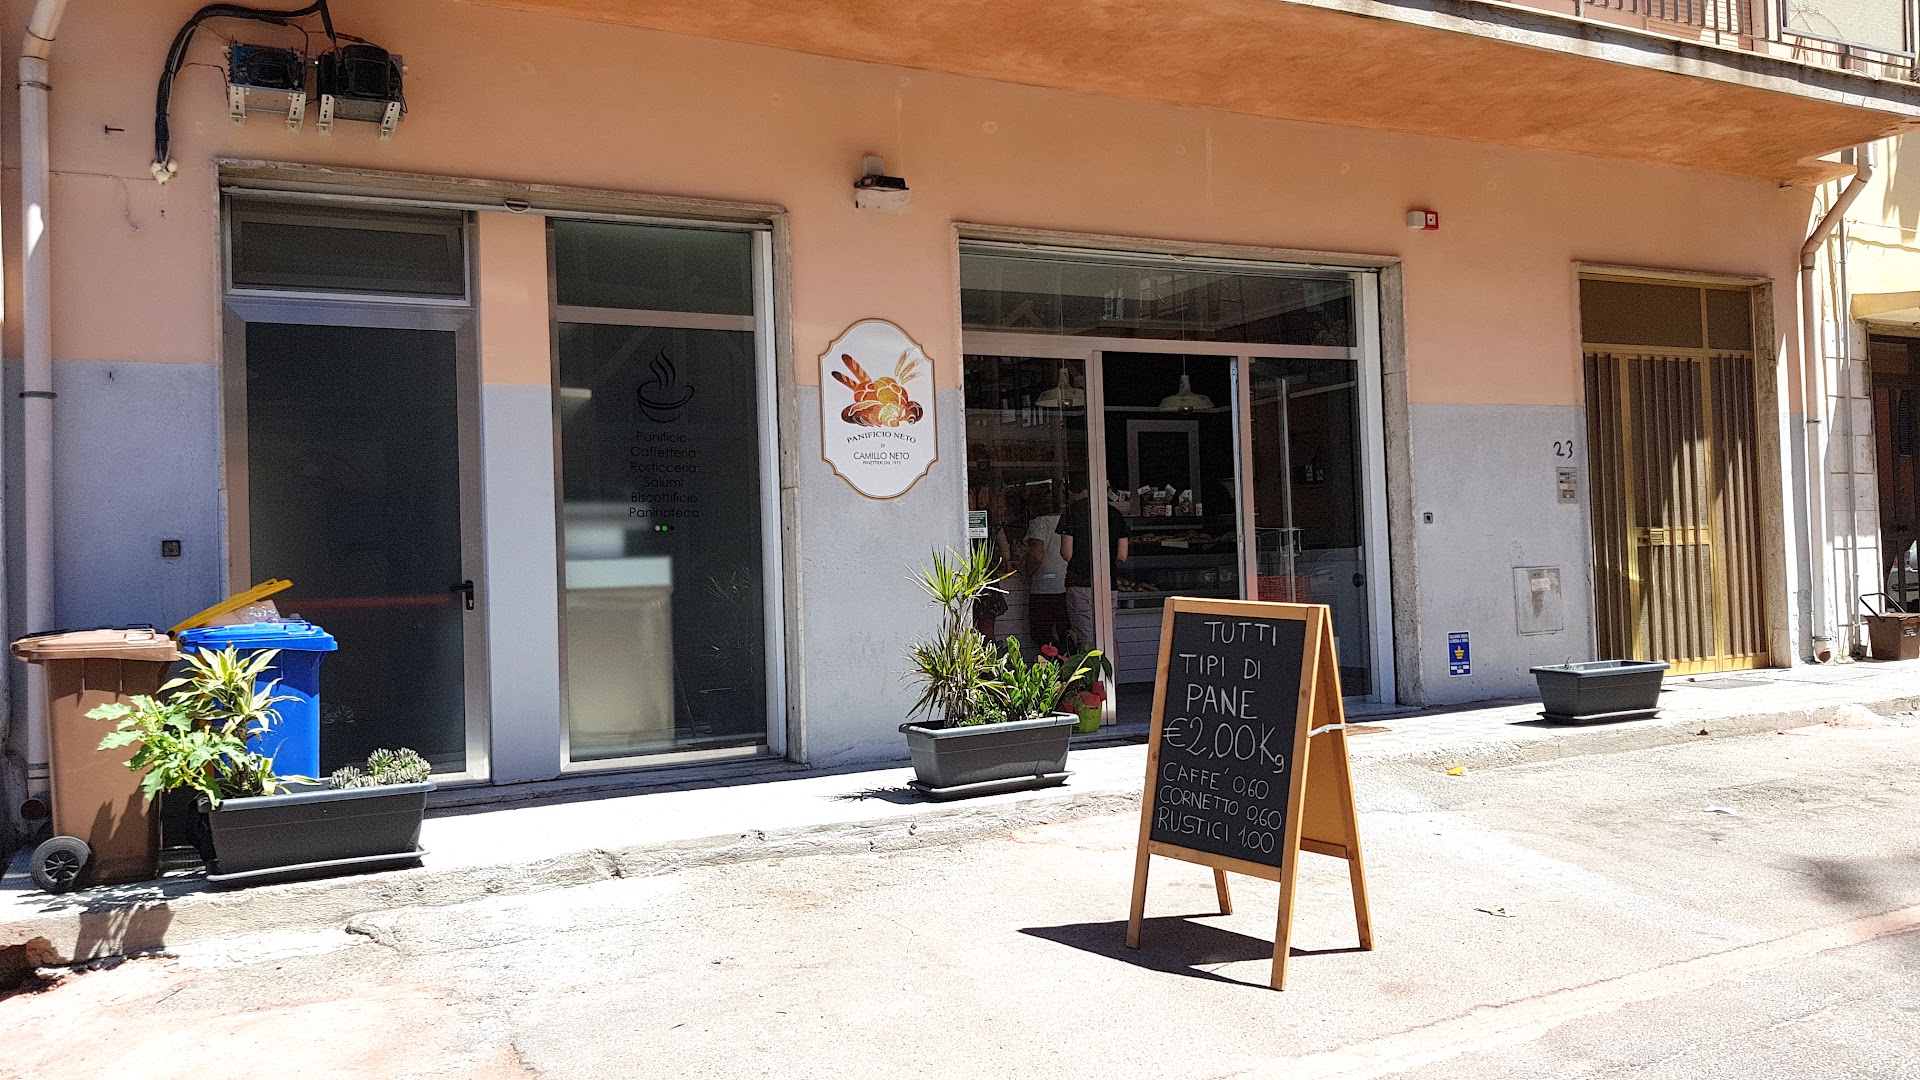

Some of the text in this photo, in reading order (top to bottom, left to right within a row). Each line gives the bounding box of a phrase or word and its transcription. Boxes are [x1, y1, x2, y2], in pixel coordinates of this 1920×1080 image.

[637, 431, 687, 443] Panificio
[847, 431, 916, 444] PANIFICIO NETO
[630, 446, 696, 459] Caffetteria
[853, 451, 910, 460] CAMILLO NETO
[1553, 440, 1573, 459] 23
[630, 461, 697, 473] Rosticceria
[644, 477, 684, 488] Salumi
[631, 492, 697, 503] Biscottificio
[629, 507, 699, 518] Paninoteca
[1204, 621, 1276, 646] TUTTI
[1179, 654, 1261, 680] TIPI DI
[1186, 683, 1257, 719] PANE
[1233, 775, 1269, 799] 0,60
[1159, 785, 1282, 830] CORNETTO 0,60
[1157, 806, 1275, 854] RUSTICI 1,00
